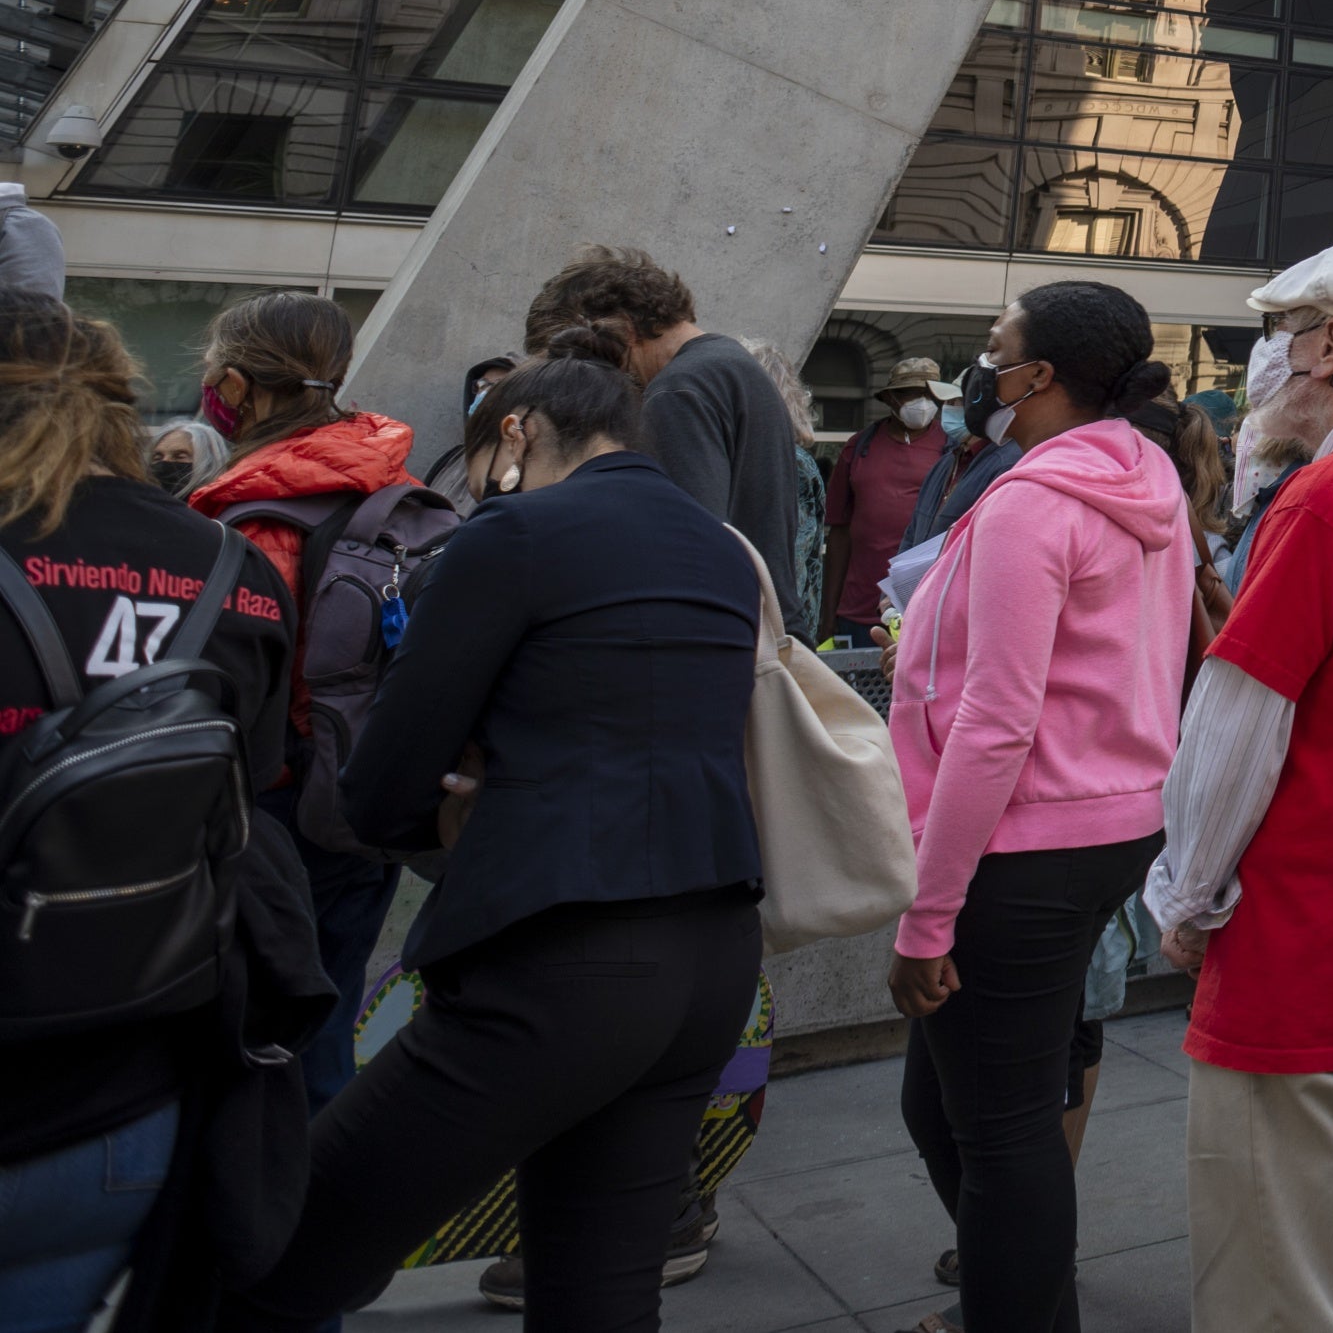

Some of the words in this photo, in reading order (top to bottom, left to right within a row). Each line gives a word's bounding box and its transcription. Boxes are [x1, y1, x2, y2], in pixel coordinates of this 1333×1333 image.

[24, 555, 143, 594] Sirviendo
[236, 586, 282, 622] Raza
[85, 594, 181, 679] 47
